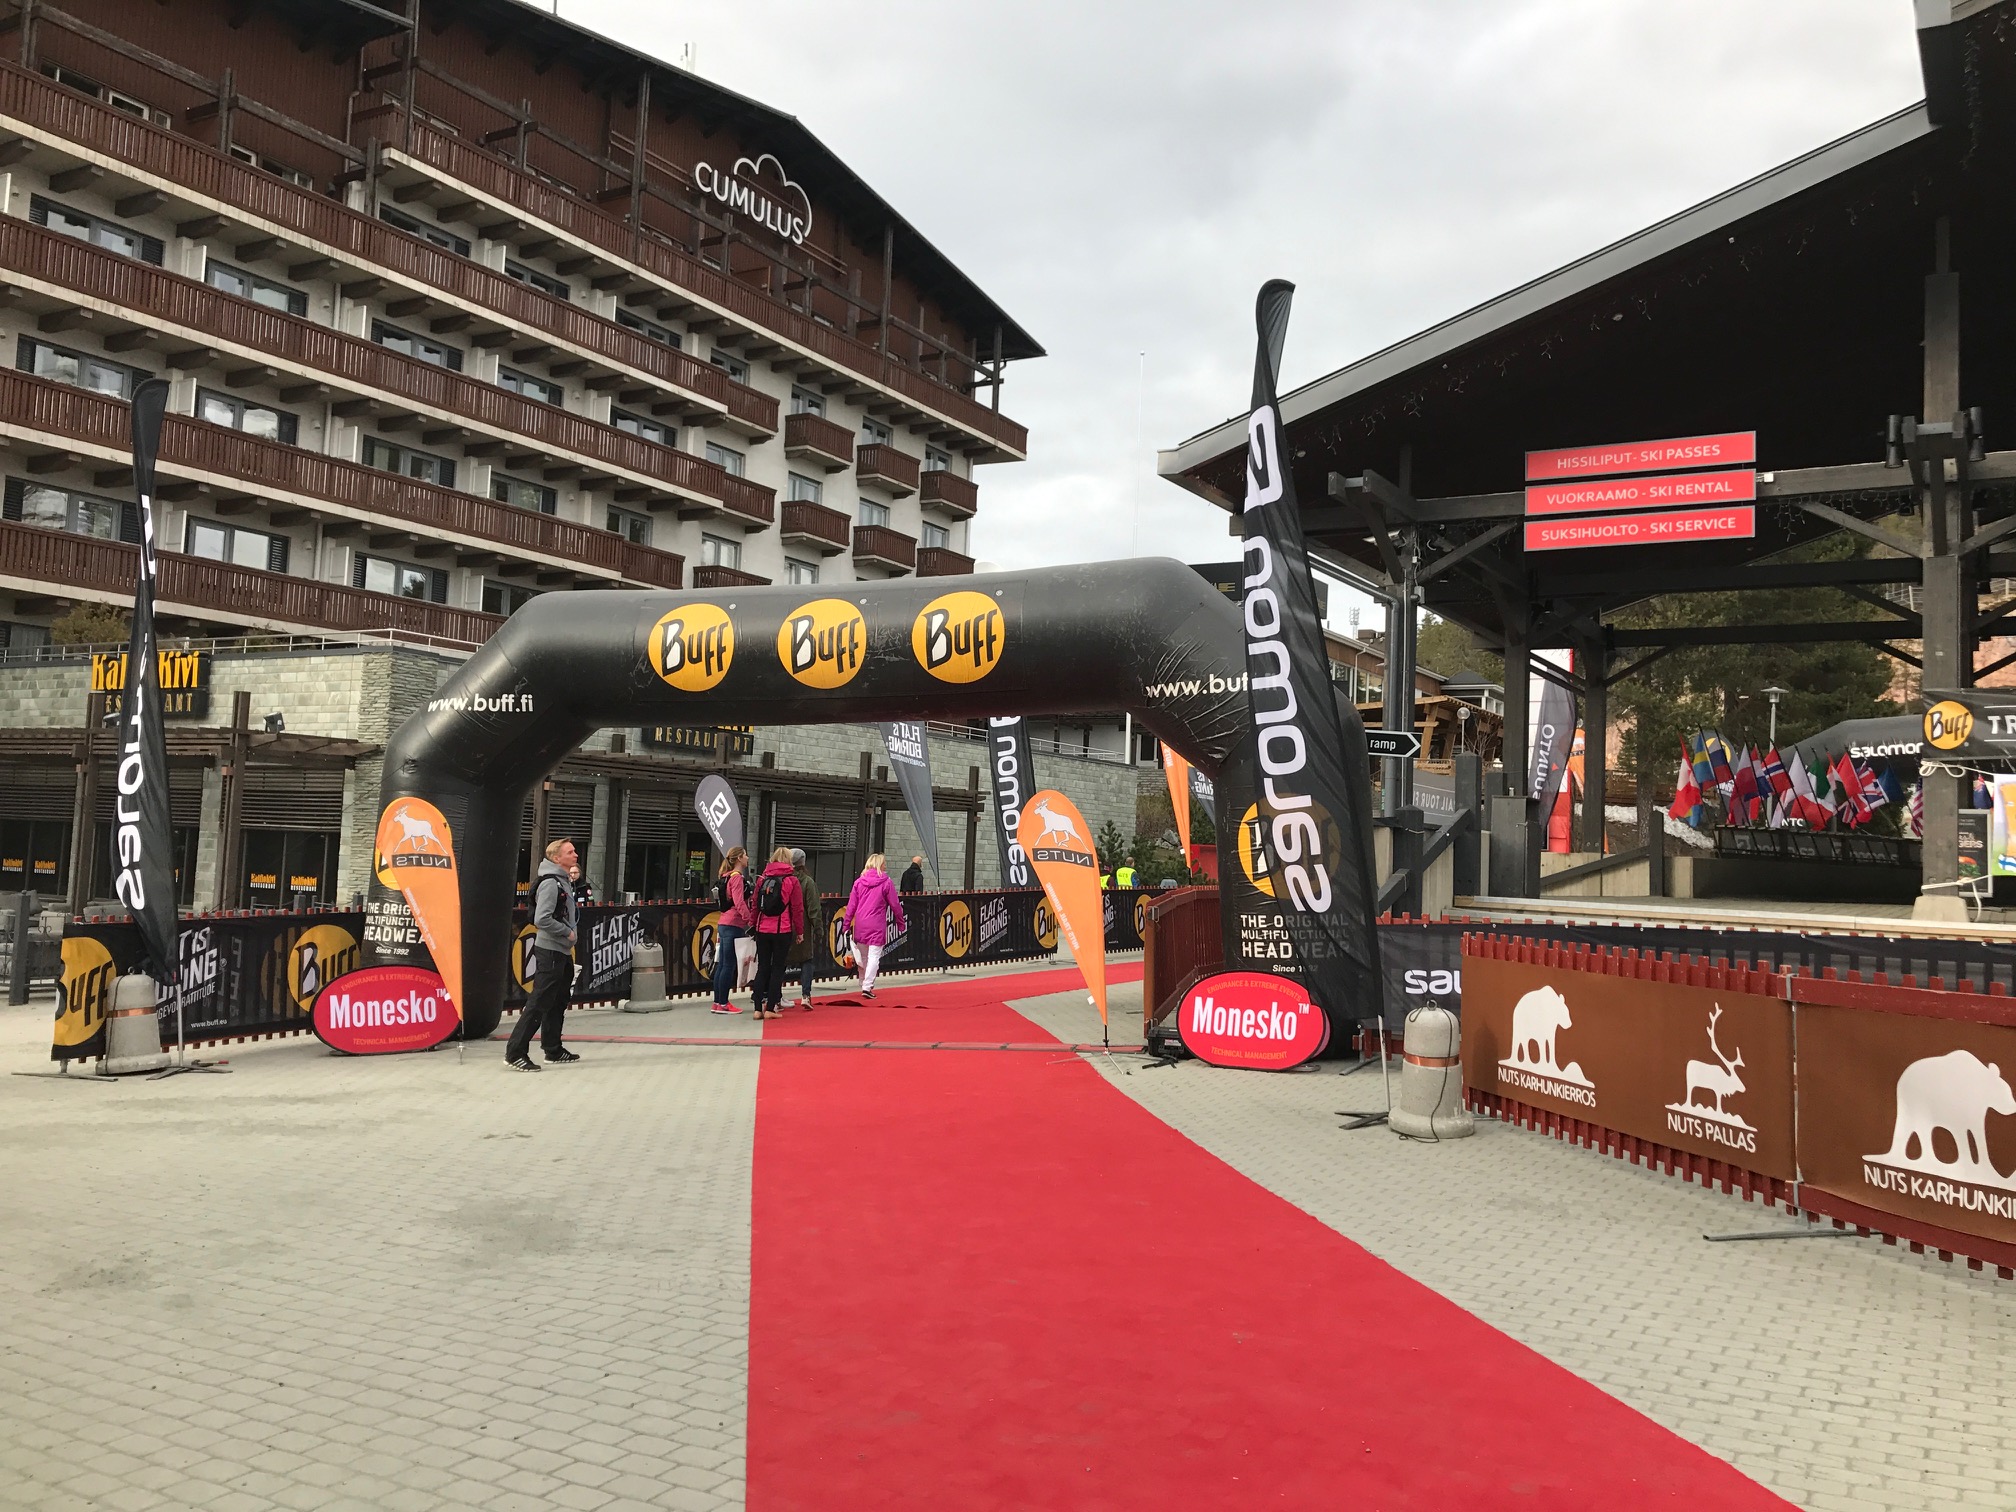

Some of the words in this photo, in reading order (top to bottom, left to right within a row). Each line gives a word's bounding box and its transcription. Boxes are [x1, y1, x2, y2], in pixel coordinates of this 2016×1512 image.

[695, 162, 803, 244] CUMULUS
[1640, 449, 1662, 462] SKI
[1666, 444, 1720, 460] PASSES
[1547, 488, 1638, 505] VUOKRAAMO
[1650, 486, 1672, 498] SKI
[1676, 480, 1732, 496] RENTAL
[1541, 523, 1639, 541] SUKSIHUOLTO
[1650, 522, 1672, 534] SKI
[1676, 517, 1736, 532] SERVICE
[428, 693, 534, 712] www.buff.fi
[1370, 739, 1396, 751] ramp
[980, 898, 998, 923] FLAT
[1240, 914, 1267, 928] THE
[592, 913, 627, 950] FLAT
[628, 912, 640, 931] IS
[980, 908, 1008, 942] BORING
[191, 927, 210, 955] IS
[375, 946, 392, 955] Since
[393, 947, 409, 955] 1992
[1272, 964, 1295, 973] Since
[1207, 980, 1244, 994] ENDURANCE
[1250, 980, 1279, 991] EXTREME
[1279, 986, 1303, 1002] EVENTS
[329, 989, 437, 1029] Monesko
[1192, 996, 1298, 1041] Monesko
[1211, 1046, 1243, 1059] TECHNICAL
[1244, 1050, 1287, 1060] MANAGEMENT
[1498, 1066, 1519, 1086] NUTS
[1520, 1073, 1596, 1108] KARHUNKIERROS
[1667, 1112, 1702, 1138] NUTS
[1705, 1122, 1756, 1153] PALLAS
[1864, 1164, 1908, 1194] NUTS
